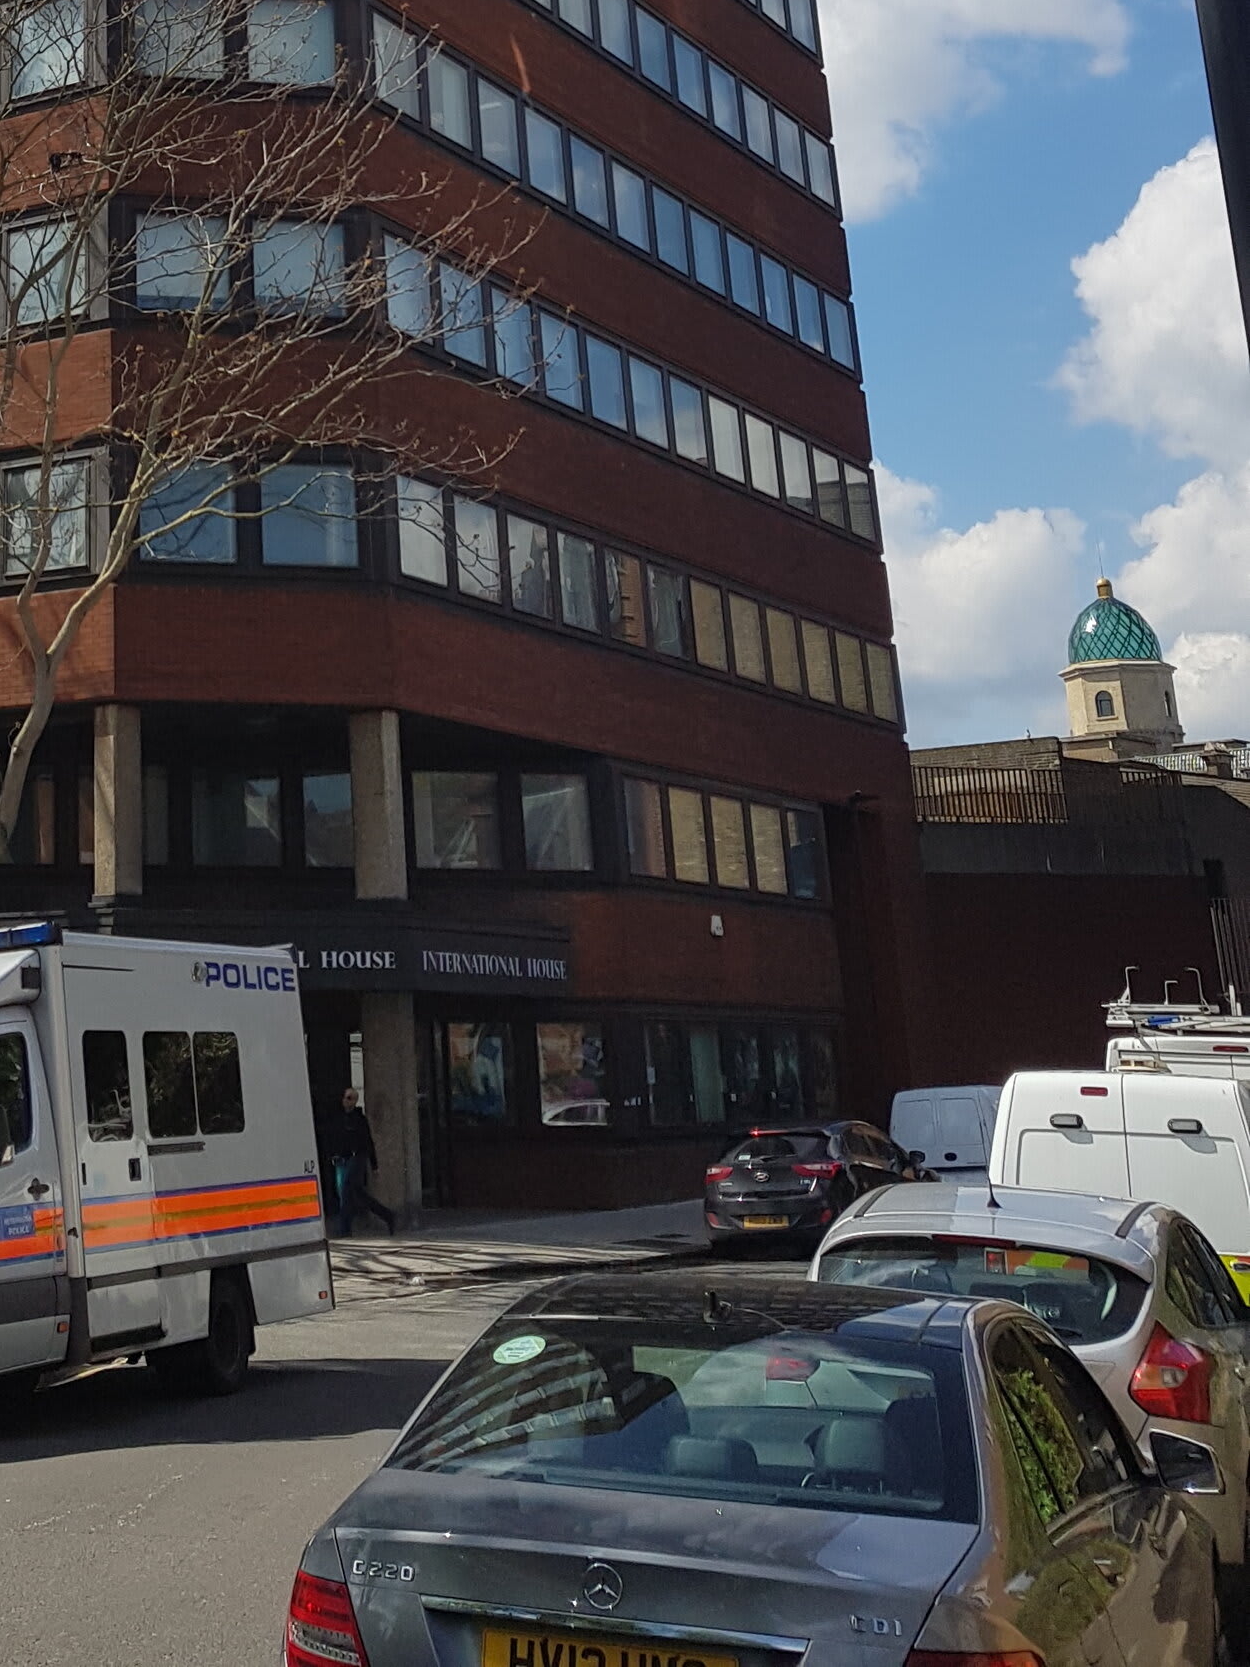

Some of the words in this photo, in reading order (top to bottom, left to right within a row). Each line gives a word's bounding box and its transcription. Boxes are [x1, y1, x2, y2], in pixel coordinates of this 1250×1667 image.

[321, 950, 396, 969] HOUSE
[423, 950, 523, 977] INTERNATIONAL
[527, 958, 566, 980] HOUSE
[204, 961, 296, 992] POLICE
